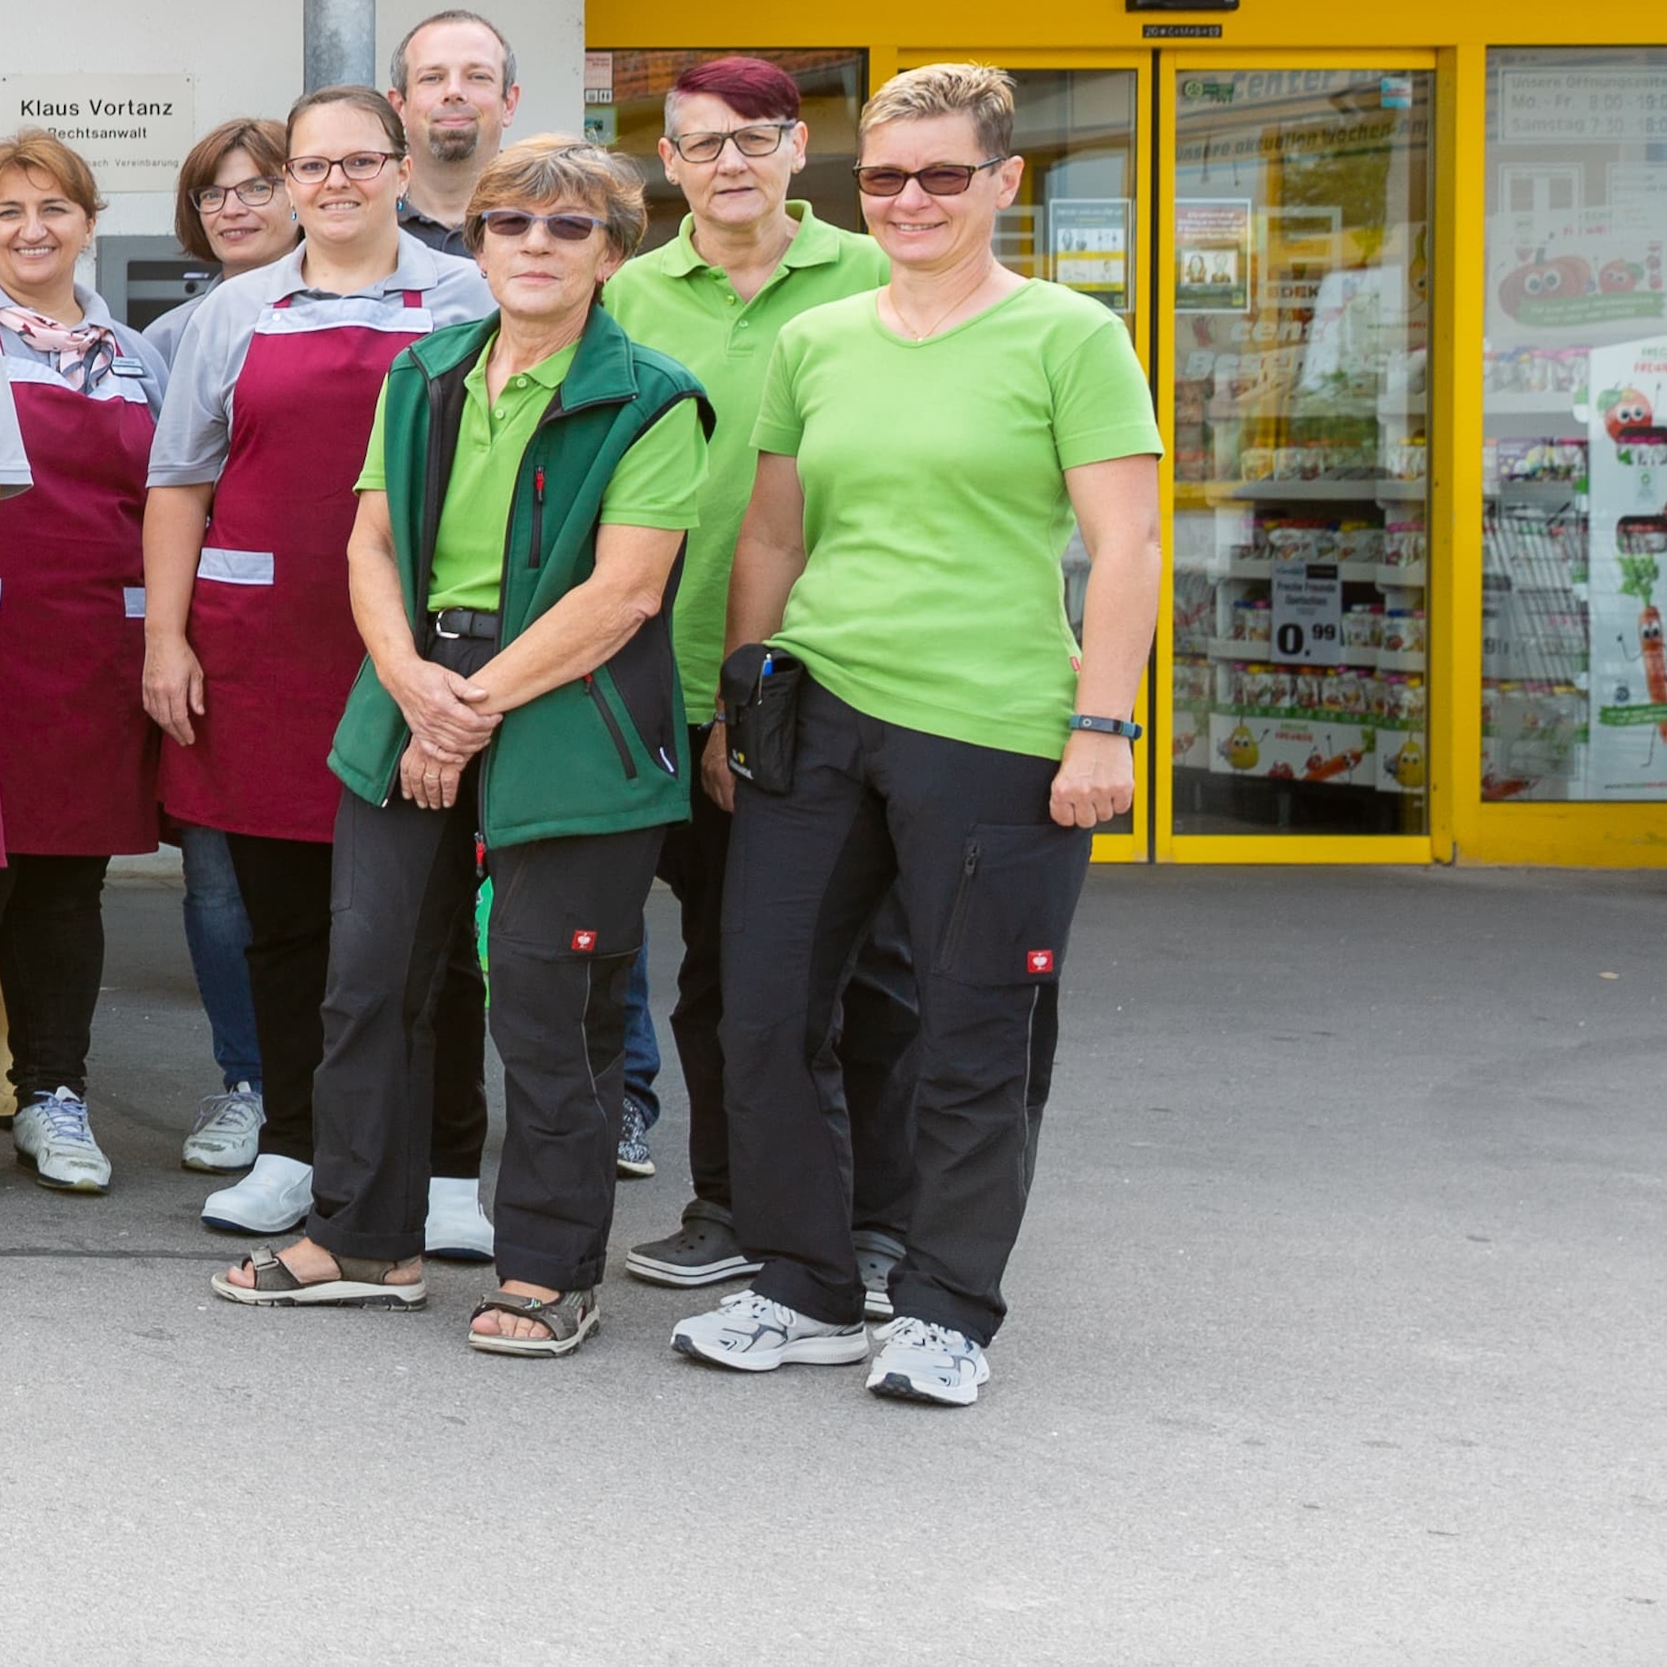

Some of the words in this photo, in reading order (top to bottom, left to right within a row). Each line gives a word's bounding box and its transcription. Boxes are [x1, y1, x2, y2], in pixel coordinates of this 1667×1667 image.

[20, 99, 80, 117] Klaus
[89, 99, 173, 117] Vortanz
[48, 127, 148, 140] Rechtsanwalt
[115, 158, 179, 169] Vereinbarung
